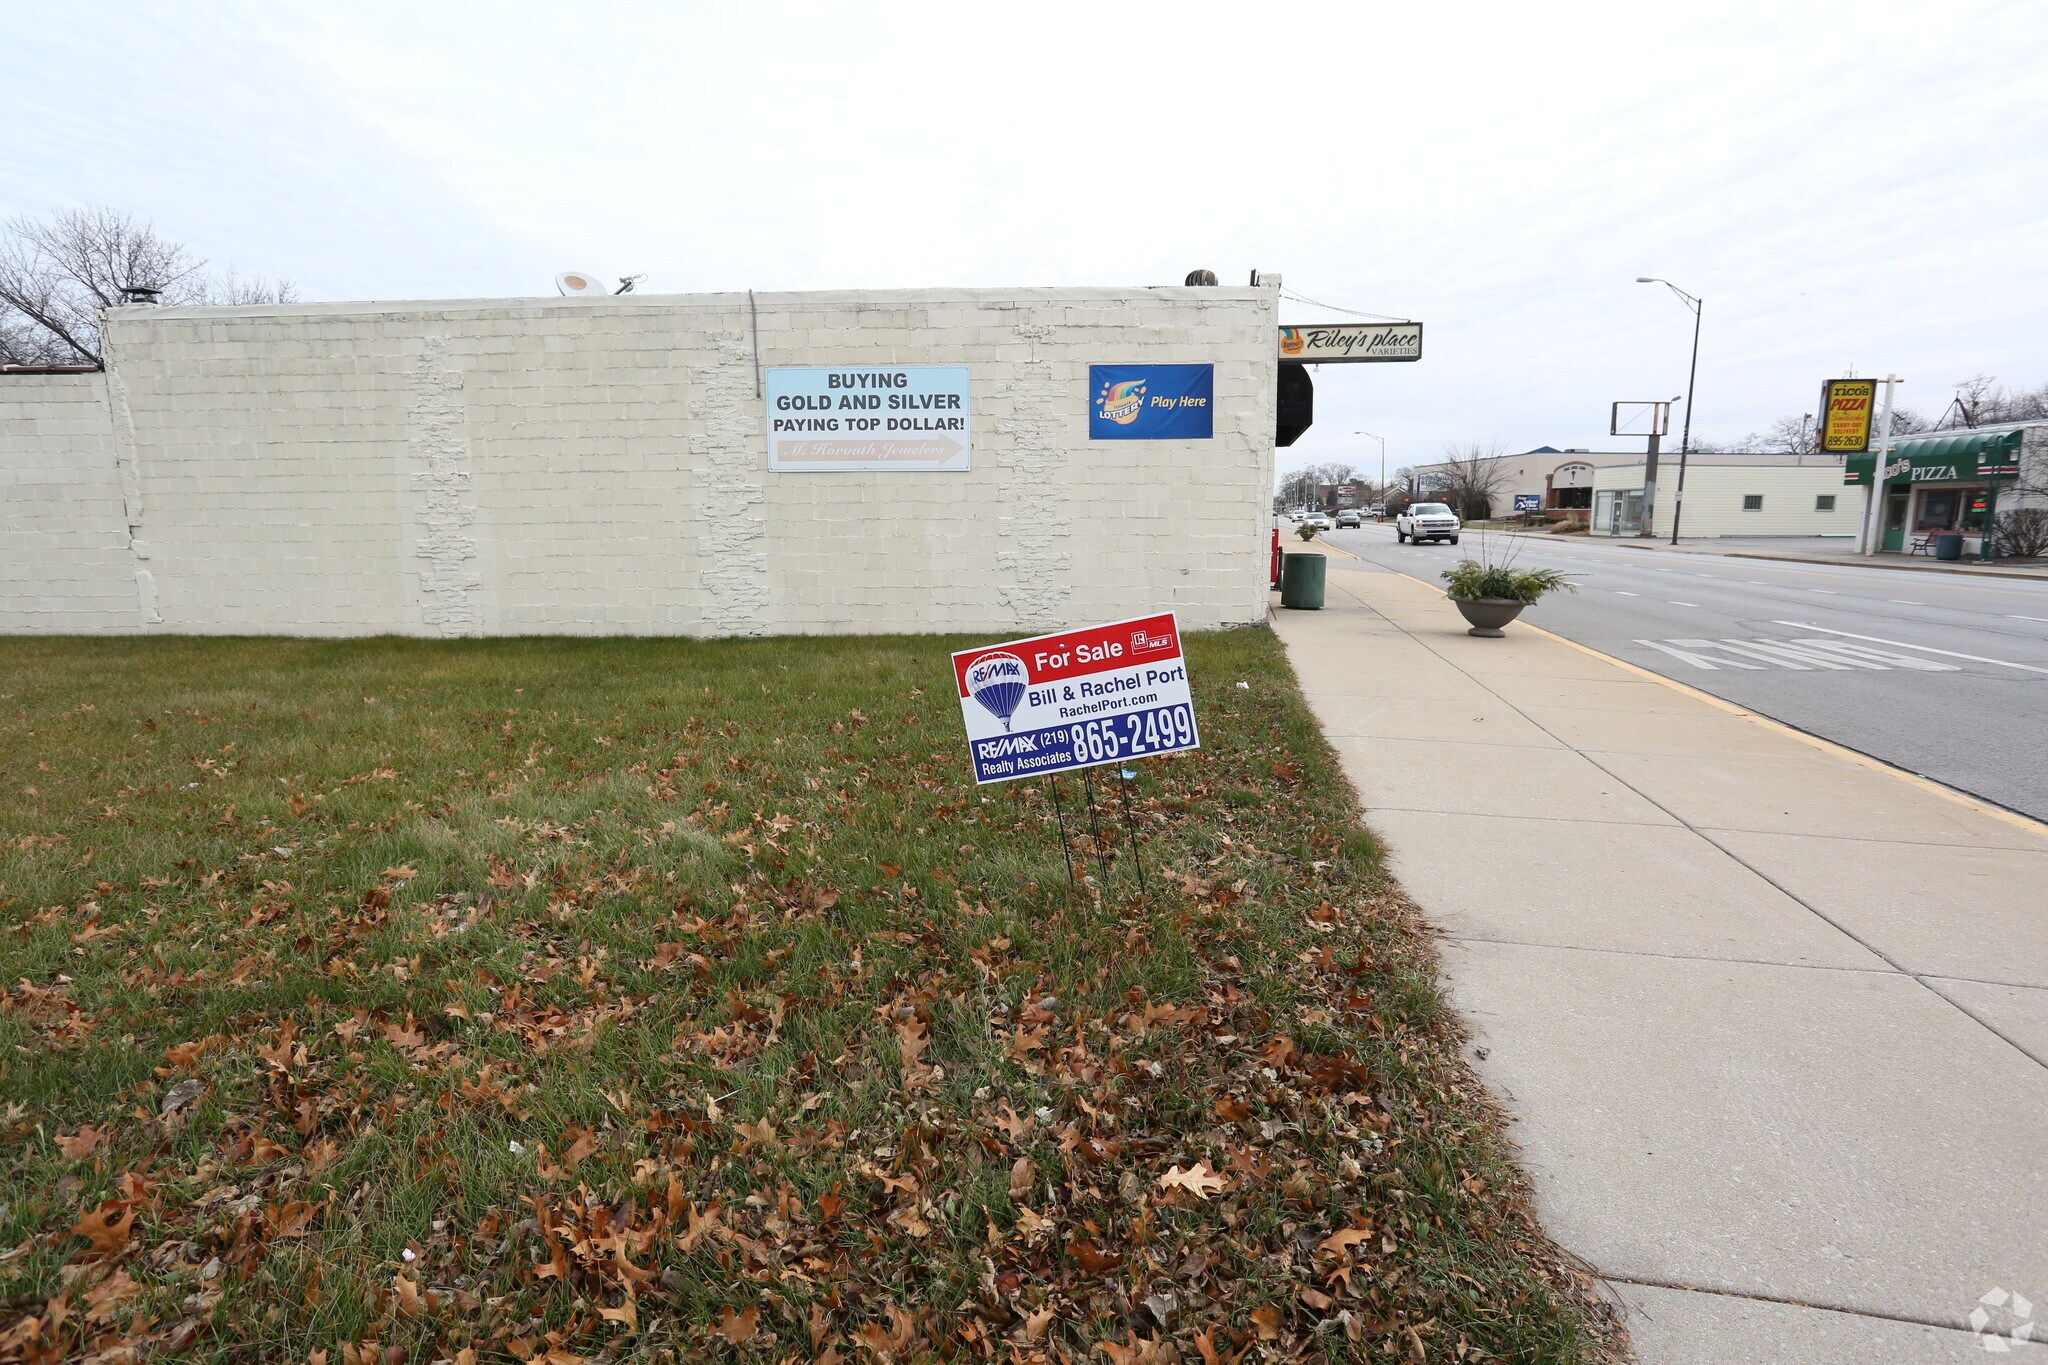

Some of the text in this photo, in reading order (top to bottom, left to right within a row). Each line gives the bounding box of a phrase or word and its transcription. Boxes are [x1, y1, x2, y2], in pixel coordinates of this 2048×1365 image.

[1307, 328, 1417, 355] Riley's place
[1371, 347, 1418, 355] VARIETIES
[828, 372, 907, 389] BUYING
[1834, 384, 1870, 396] rico's
[776, 394, 961, 411] GOLD AND SILVER
[1099, 395, 1145, 420] LOTTERY
[1150, 396, 1207, 410] Play Here
[1829, 398, 1868, 411] PIZZA
[773, 417, 965, 432] PAYING TOP DOLLAR!
[1827, 435, 1863, 447] 895-2630
[811, 442, 876, 456] Horvath
[878, 442, 945, 460] Jewelers
[1910, 465, 1958, 480] PIZZA
[1149, 639, 1168, 648] MLS
[1034, 640, 1123, 672] For Sale
[972, 662, 1021, 684] RE/MAX
[1028, 666, 1185, 707] Bill & Rachel Port
[1059, 692, 1158, 719] RachelPort.com
[1071, 705, 1192, 763] 865-2499
[978, 729, 1069, 760] RE/MAX (219)
[981, 751, 1072, 776] Realty Associates
